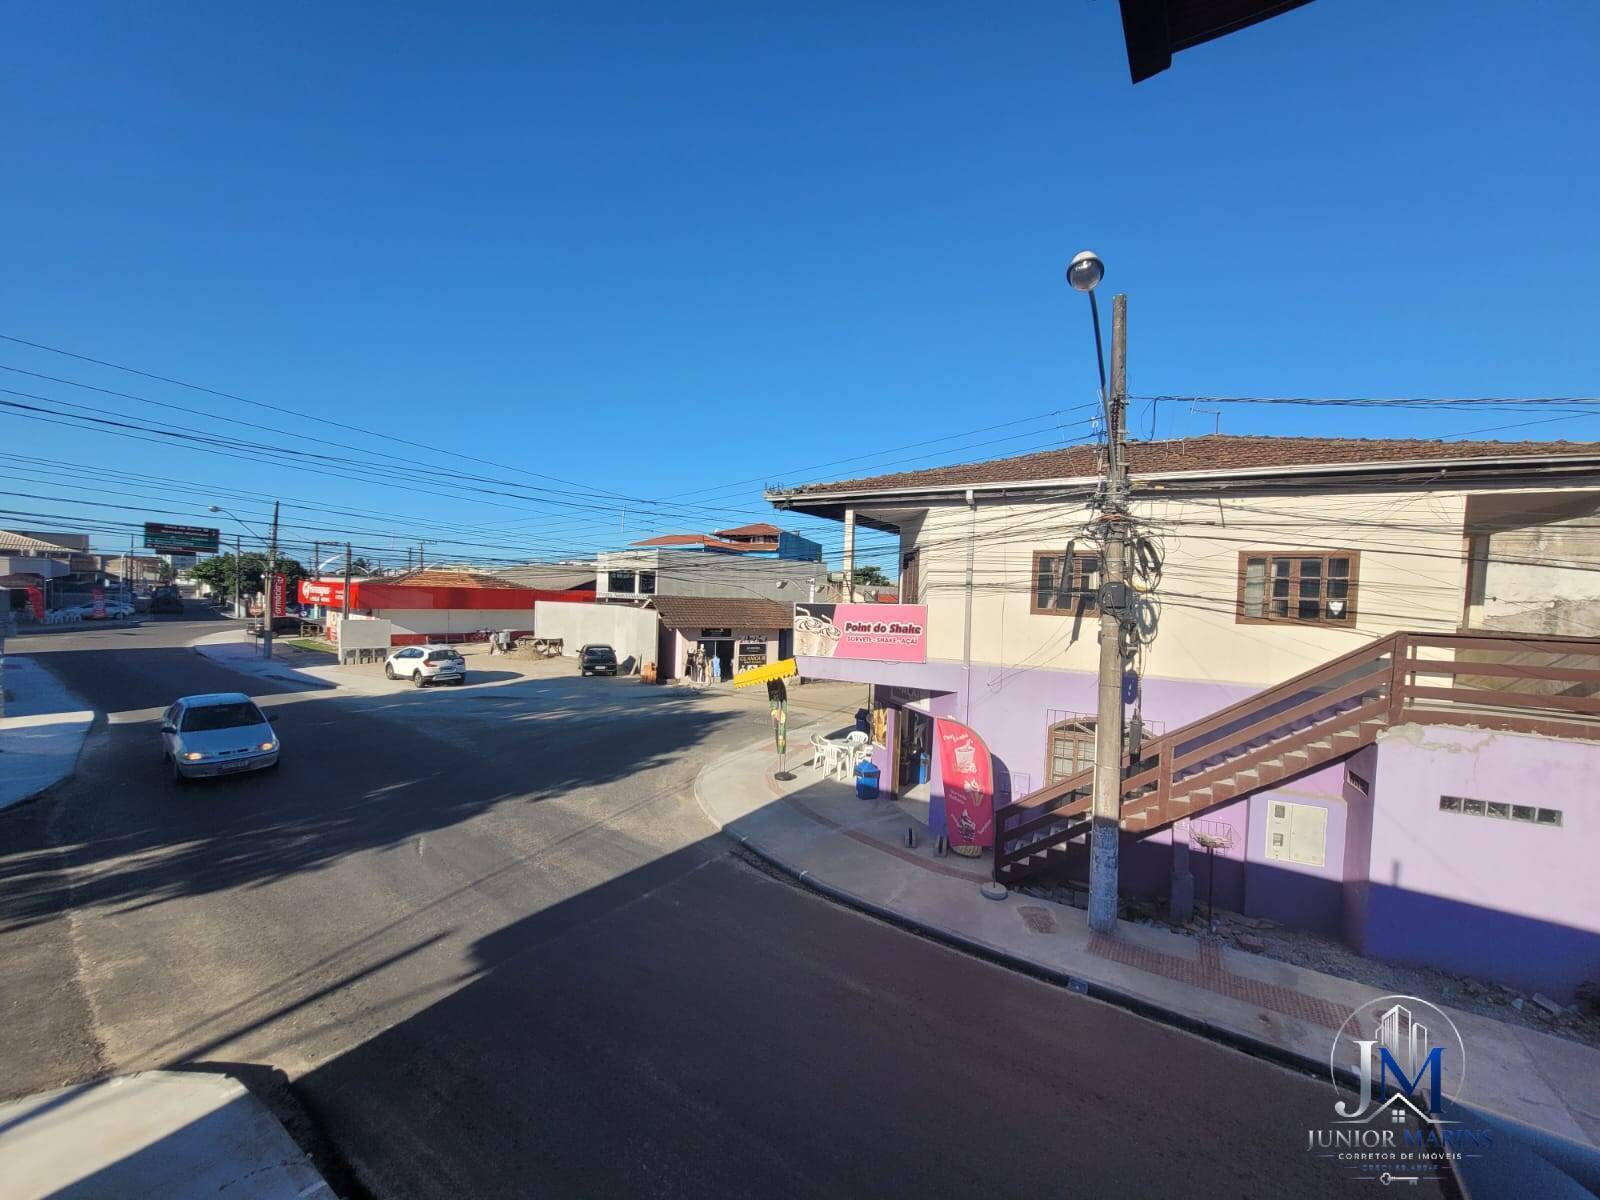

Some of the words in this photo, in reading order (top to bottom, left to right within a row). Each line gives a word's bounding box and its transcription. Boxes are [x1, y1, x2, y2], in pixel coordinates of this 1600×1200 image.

[845, 622, 871, 633] Point
[873, 623, 887, 633] do
[889, 623, 922, 635] Shake
[847, 636, 873, 644] SORVETE
